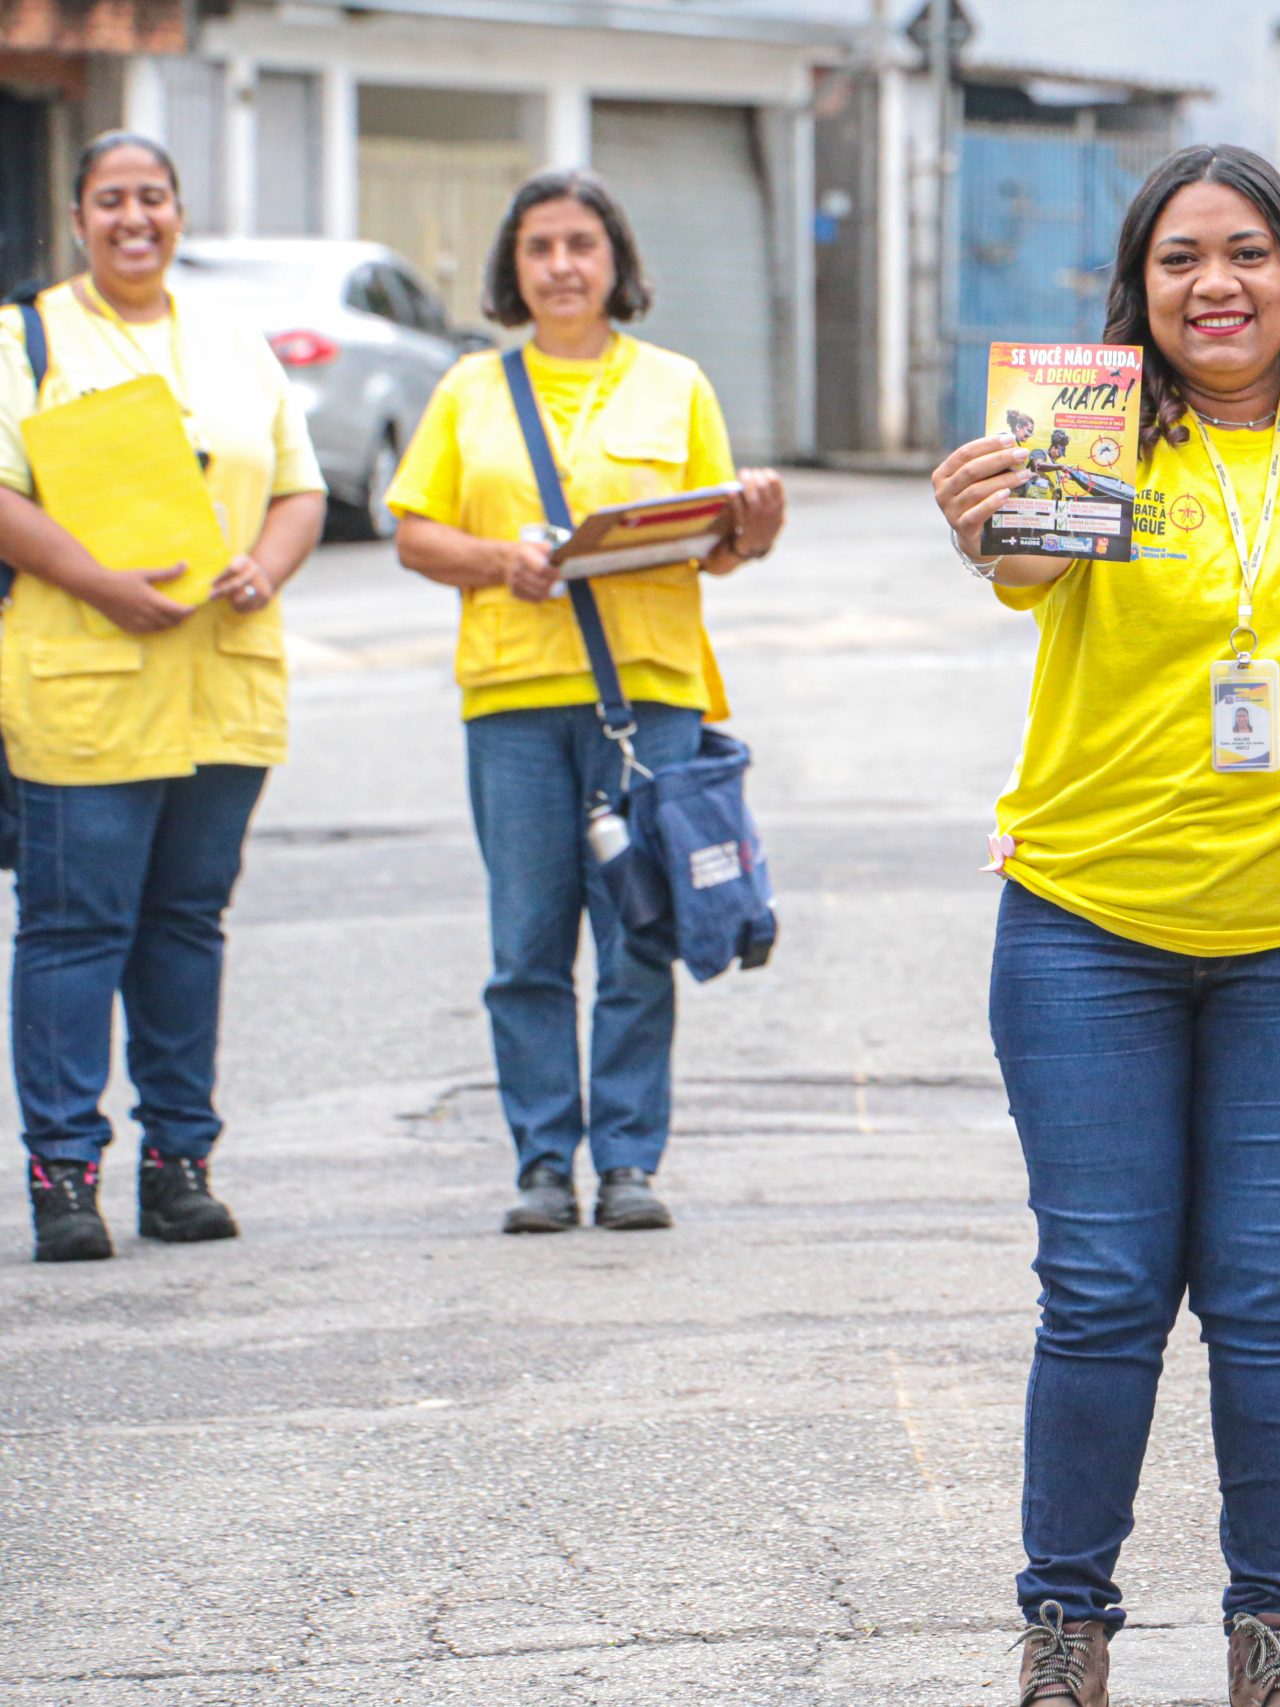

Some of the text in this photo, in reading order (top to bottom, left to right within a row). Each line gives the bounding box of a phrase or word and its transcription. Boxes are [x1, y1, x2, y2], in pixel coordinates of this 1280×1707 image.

[1011, 346, 1140, 370] SE VOCÊ NÃO CUIDA,
[1034, 368, 1098, 385] A DENGUE
[1154, 491, 1165, 503] DE
[1135, 504, 1157, 517] BATE
